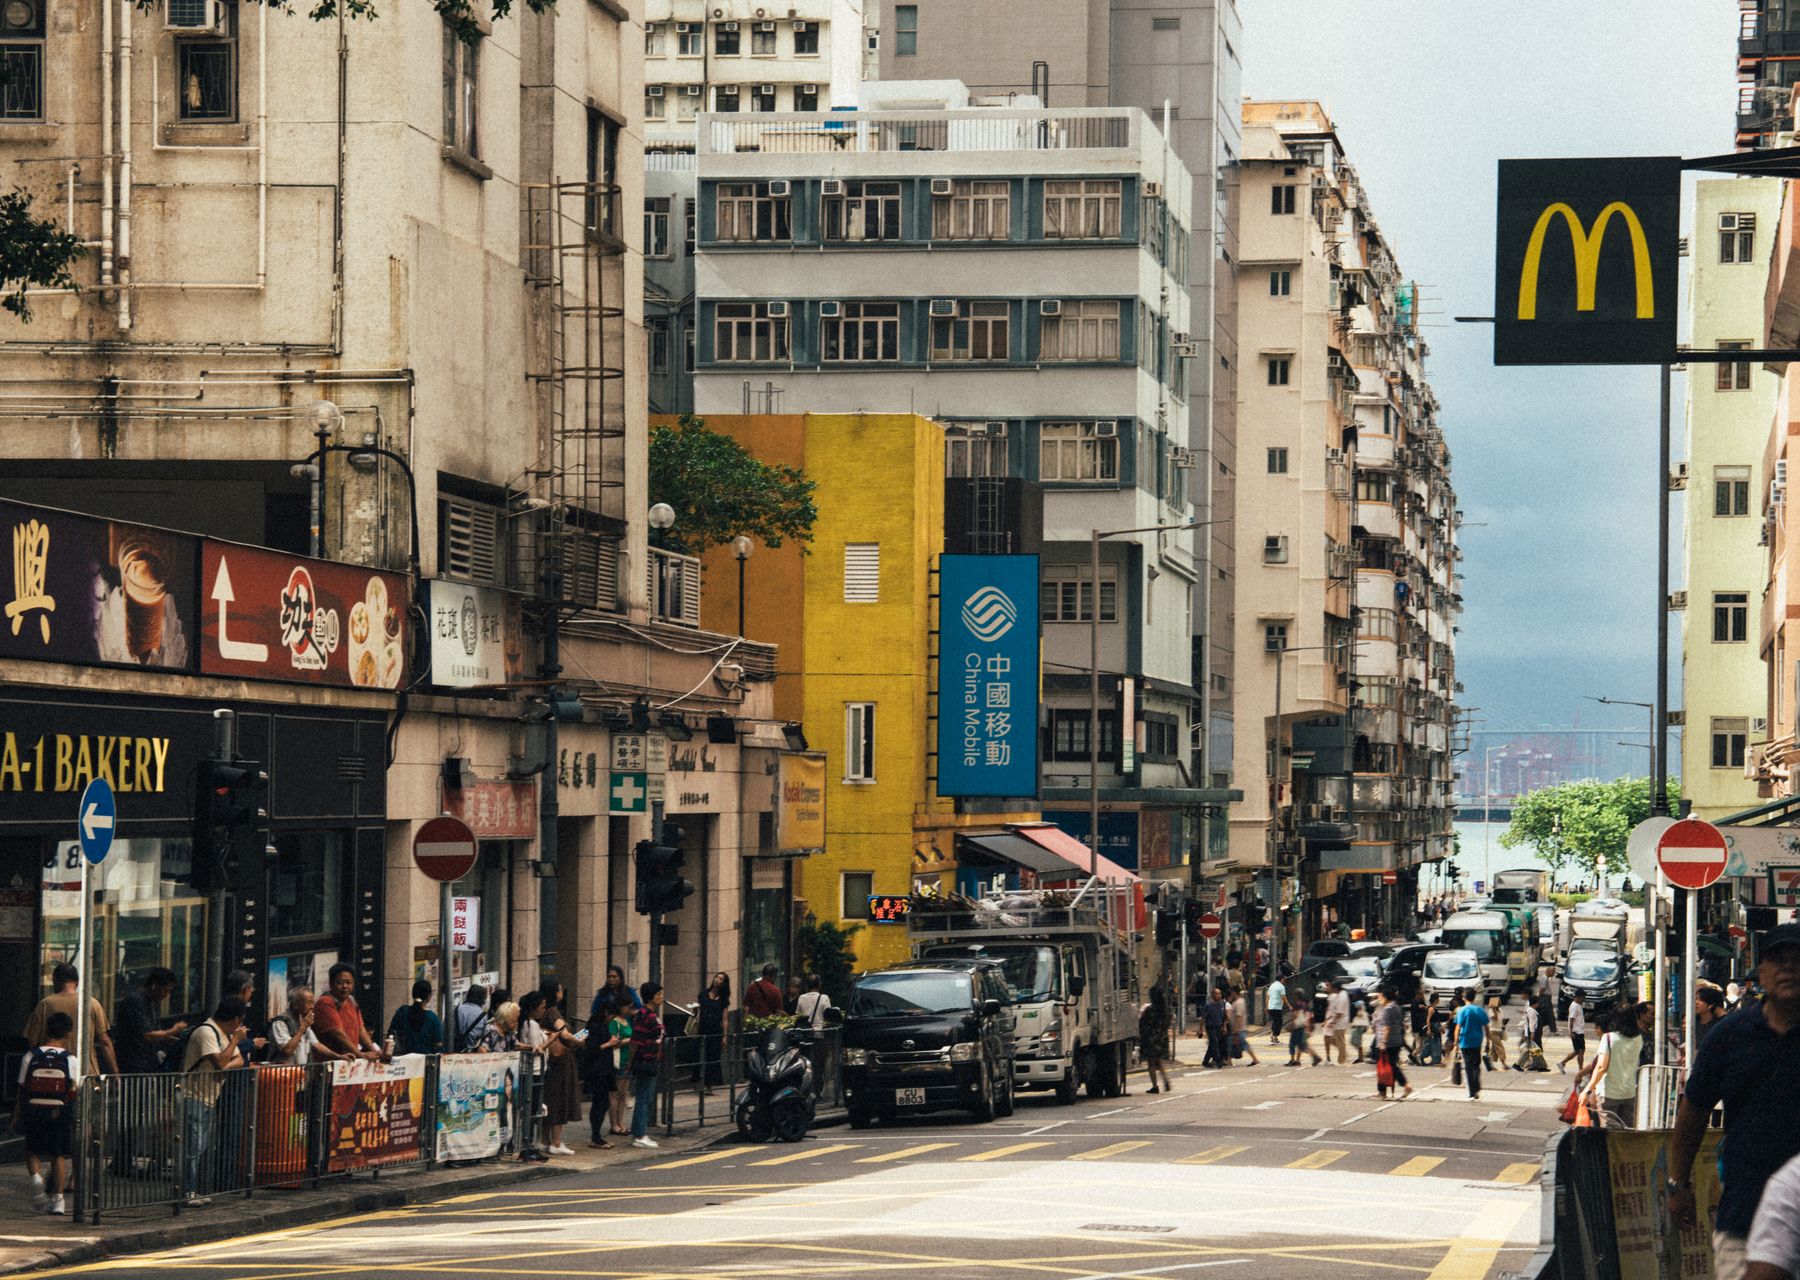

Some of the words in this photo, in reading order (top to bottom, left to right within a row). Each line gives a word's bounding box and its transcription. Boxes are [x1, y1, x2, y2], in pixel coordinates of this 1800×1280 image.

[965, 653, 981, 704] China
[985, 653, 1011, 766] 中國移動
[0, 732, 44, 791] A-1
[54, 734, 169, 792] BAKERY
[964, 709, 981, 766] Mobile
[453, 899, 467, 946] 兩餸飯
[905, 1089, 917, 1097] CU
